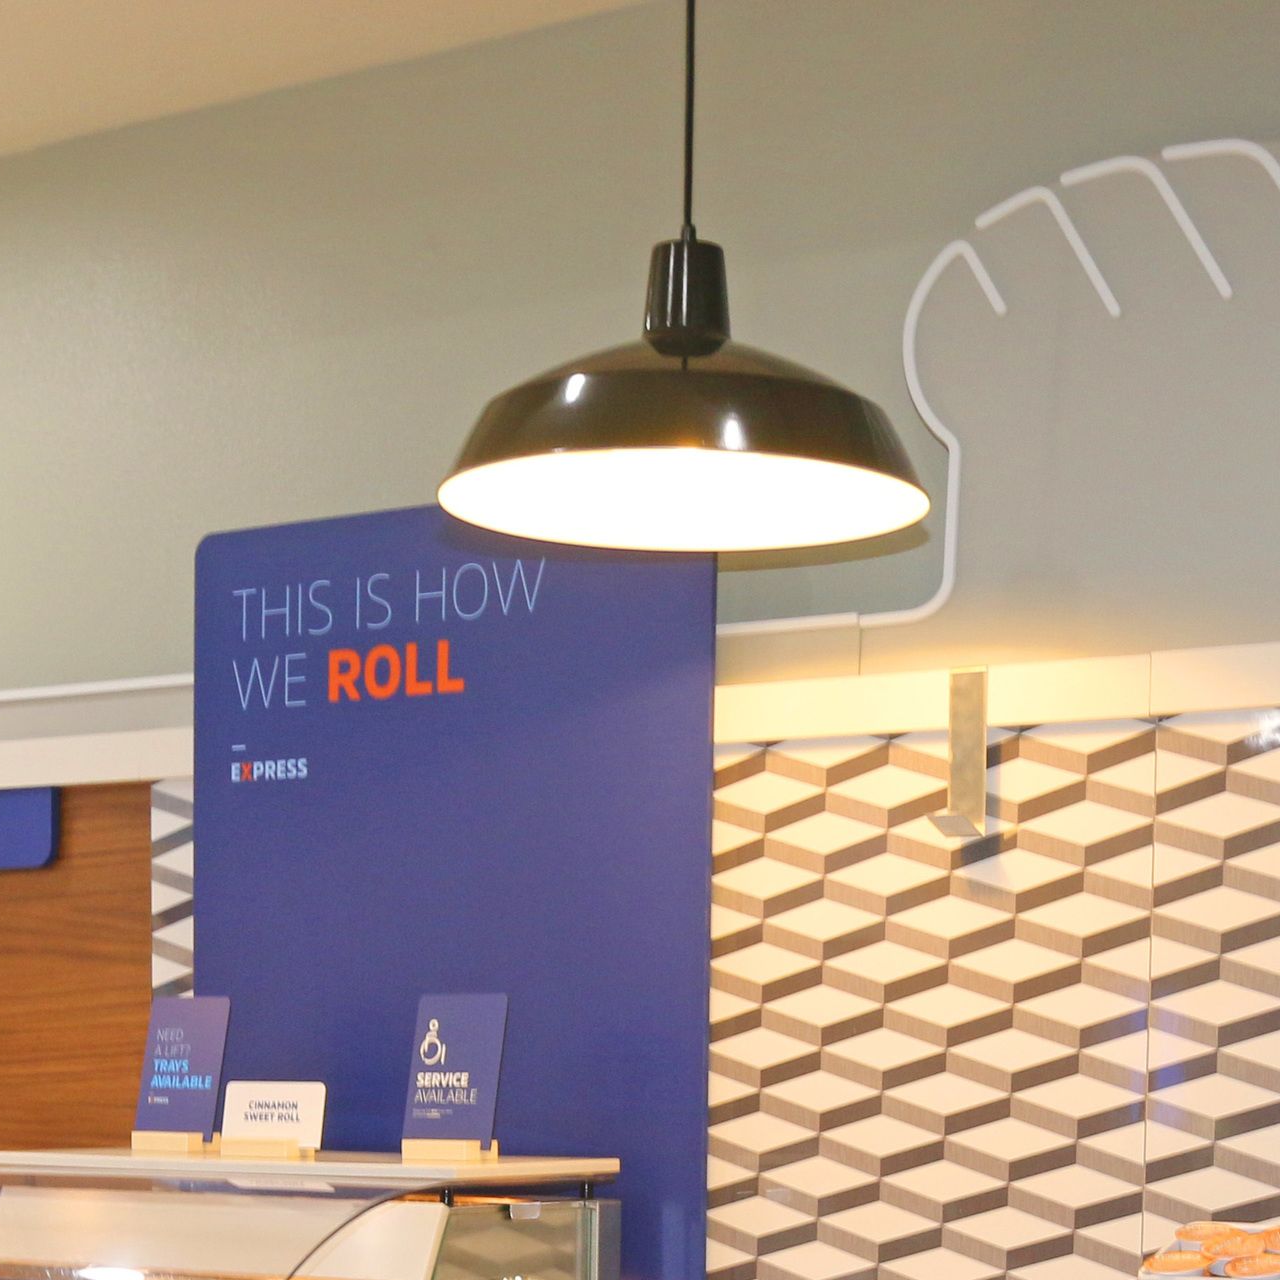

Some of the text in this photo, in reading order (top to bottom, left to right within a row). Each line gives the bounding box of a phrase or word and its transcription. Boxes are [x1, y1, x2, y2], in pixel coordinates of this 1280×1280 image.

[232, 556, 546, 642] THIS IS HOW
[232, 639, 465, 710] WE ROLL
[231, 757, 308, 783] EXPRESS
[157, 1028, 184, 1042] NEED
[155, 1044, 162, 1056] A
[153, 1059, 189, 1073] TRAYS
[150, 1075, 213, 1089] AVAILABLE
[416, 1072, 469, 1088] SERVICE
[414, 1088, 478, 1105] AVAILABLE
[248, 1100, 298, 1111] CINNAMON
[244, 1111, 300, 1122] SWEET ROLL
